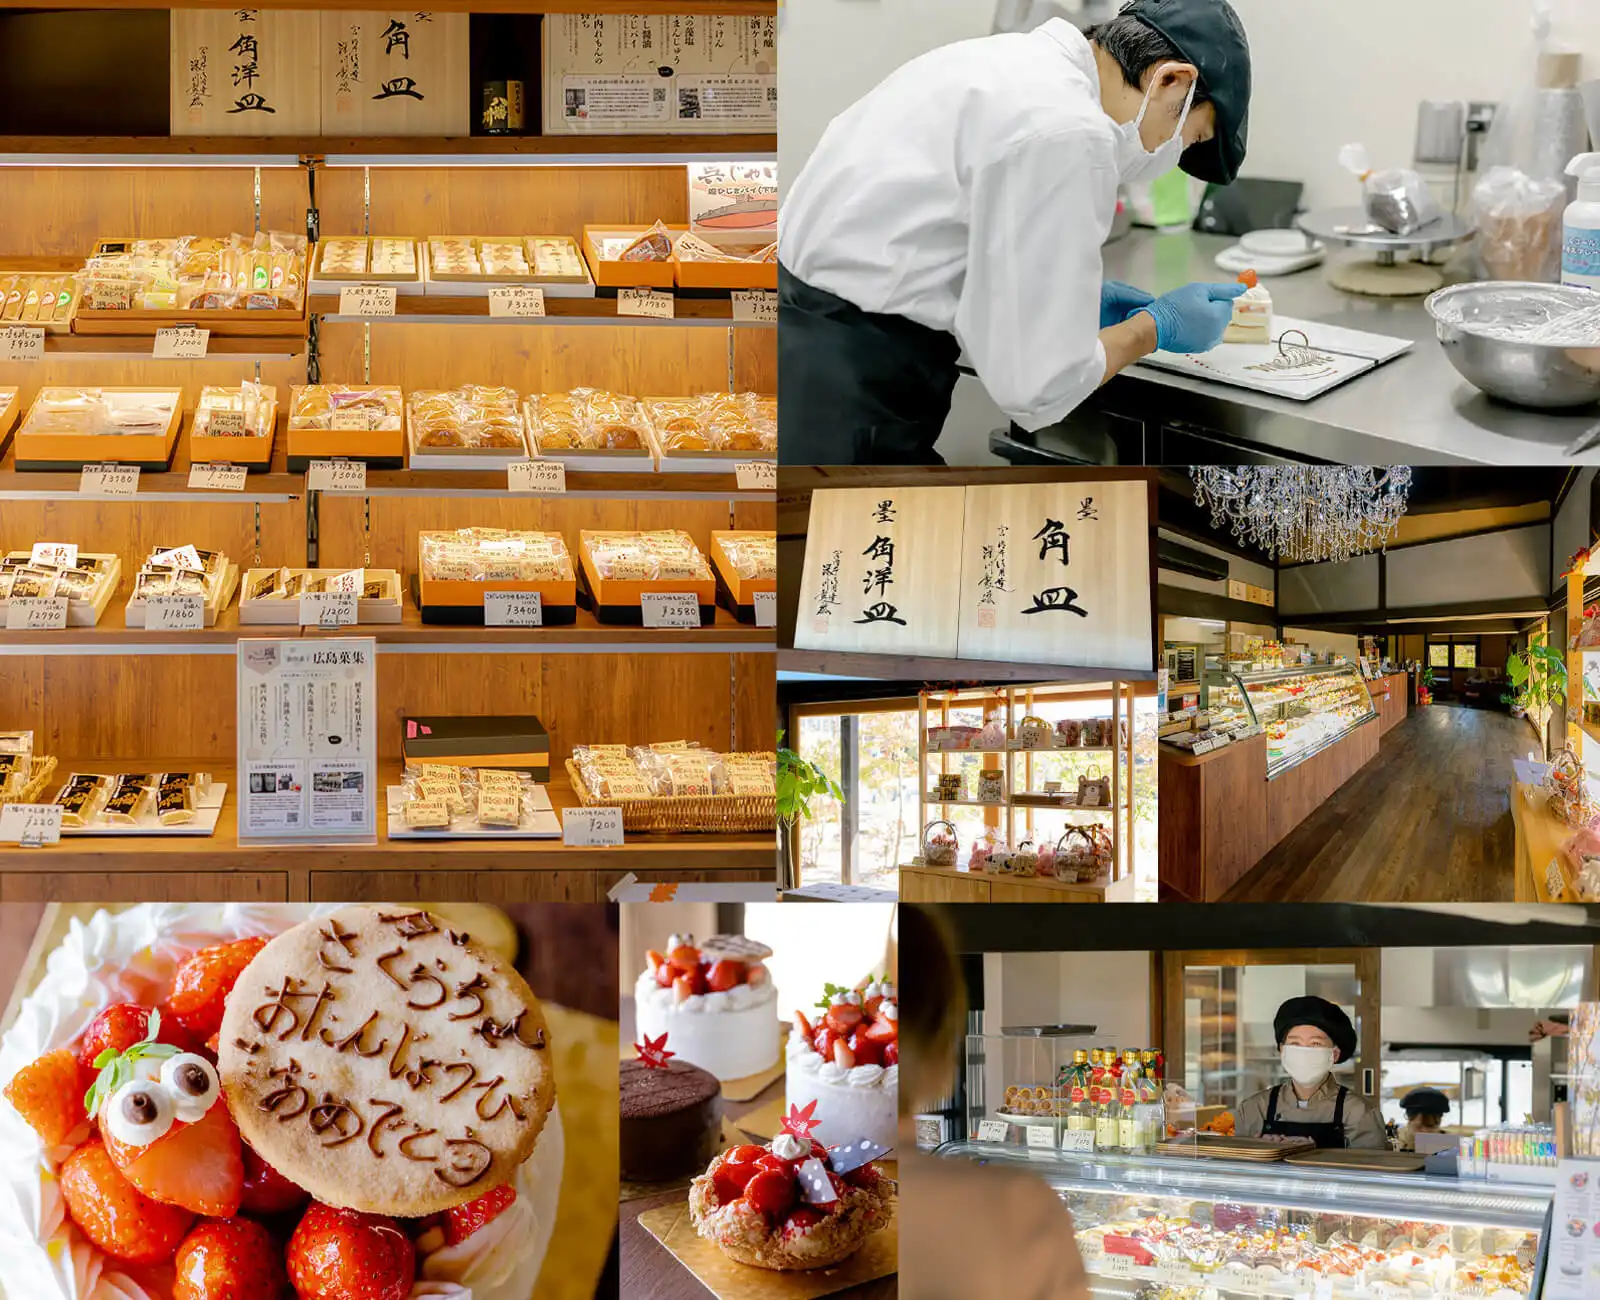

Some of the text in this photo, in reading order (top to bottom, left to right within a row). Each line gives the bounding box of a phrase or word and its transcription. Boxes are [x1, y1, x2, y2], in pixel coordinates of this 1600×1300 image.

[642, 15, 652, 49] し醤油
[672, 15, 682, 65] まんじゅう
[226, 33, 277, 114] 角洋皿
[853, 535, 907, 626] 角洋皿
[1020, 518, 1088, 618] 角皿
[162, 609, 194, 620] ¥1860
[320, 606, 350, 618] ¥1200
[507, 605, 537, 616] ¥3400
[661, 605, 696, 618] ¥2580
[590, 818, 616, 832] ¥200
[252, 975, 537, 1122] おたんじょうび
[256, 1057, 492, 1188] おめでとう
